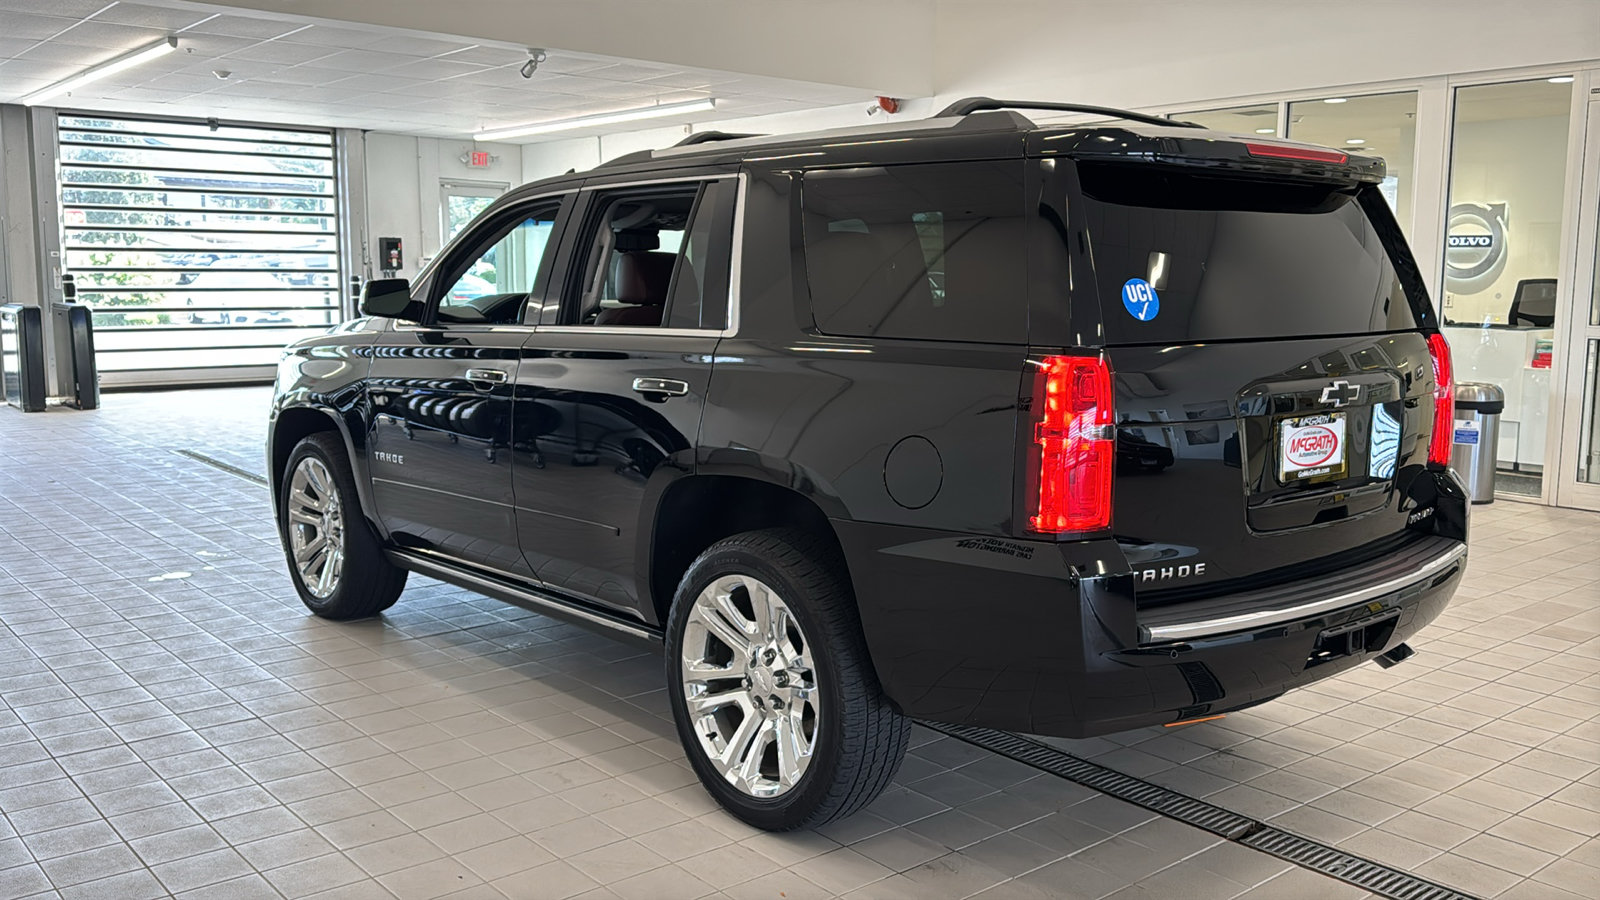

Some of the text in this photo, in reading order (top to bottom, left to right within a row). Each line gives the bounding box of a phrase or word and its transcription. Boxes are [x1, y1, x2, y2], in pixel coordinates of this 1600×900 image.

[472, 152, 488, 167] EXIT
[1449, 236, 1490, 246] OLVO
[1126, 283, 1153, 303] UCI
[374, 451, 404, 465] TAHOE
